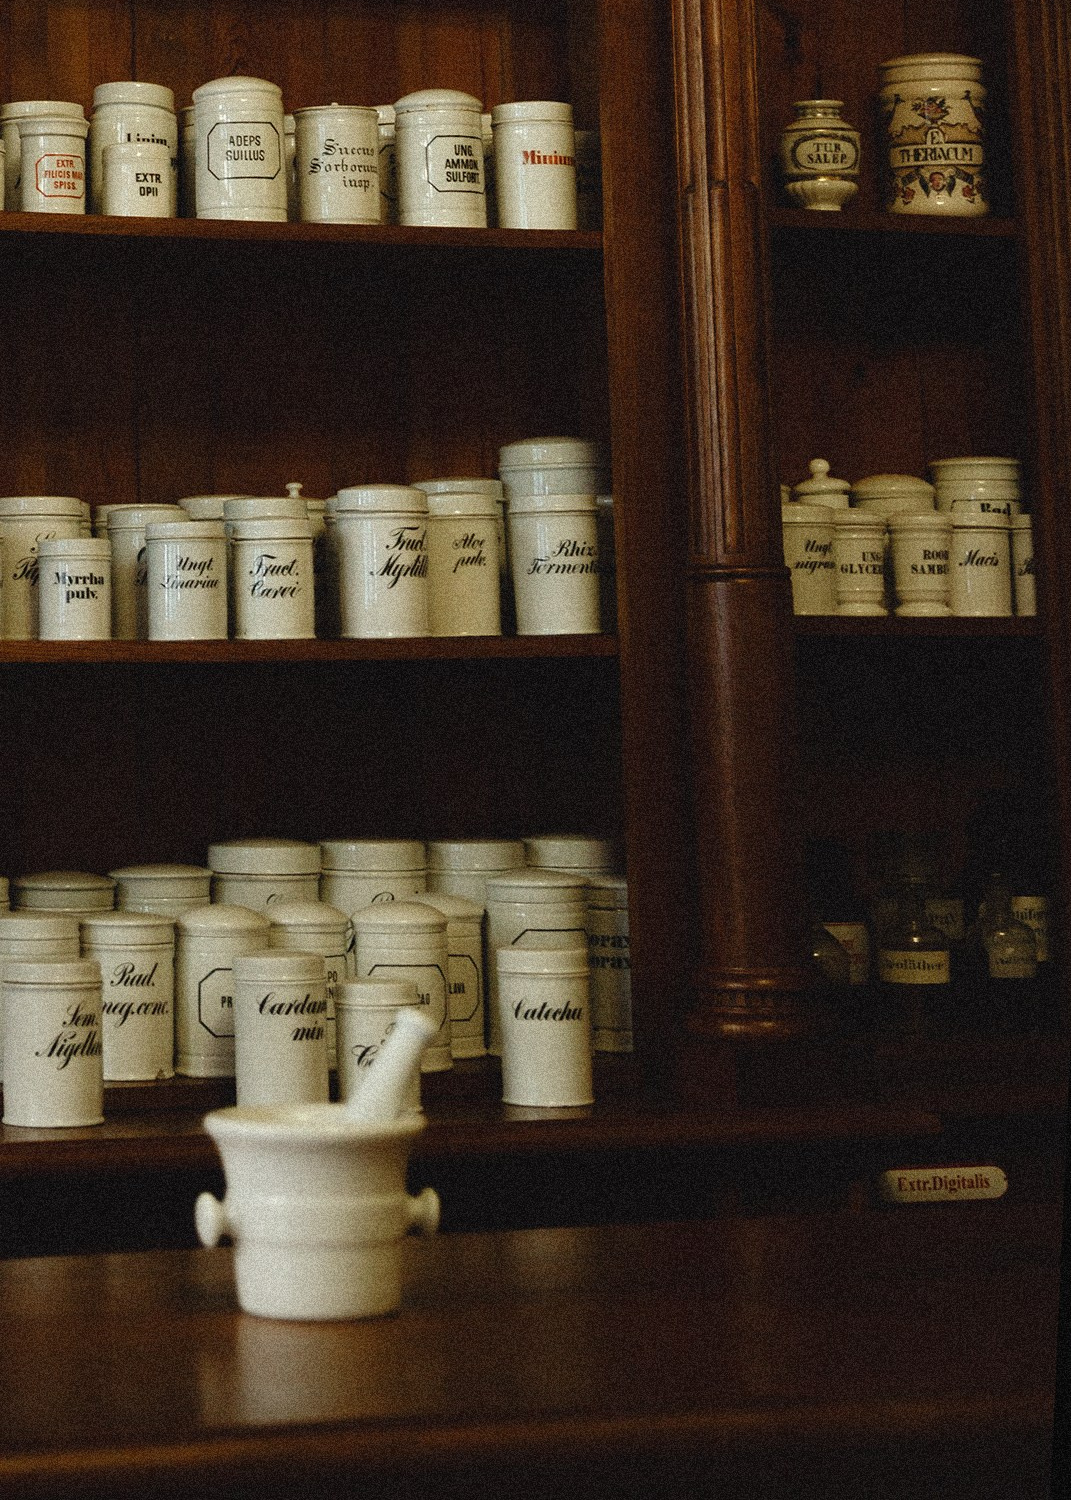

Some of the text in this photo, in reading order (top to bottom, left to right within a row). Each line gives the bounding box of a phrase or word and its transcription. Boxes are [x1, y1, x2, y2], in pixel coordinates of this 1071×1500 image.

[228, 135, 262, 147] ADEPS
[225, 149, 265, 162] SUILLUS
[54, 571, 104, 587] Myrrha
[65, 586, 99, 604] pulv.
[109, 961, 158, 988] Rad.
[511, 998, 584, 1022] Catechu
